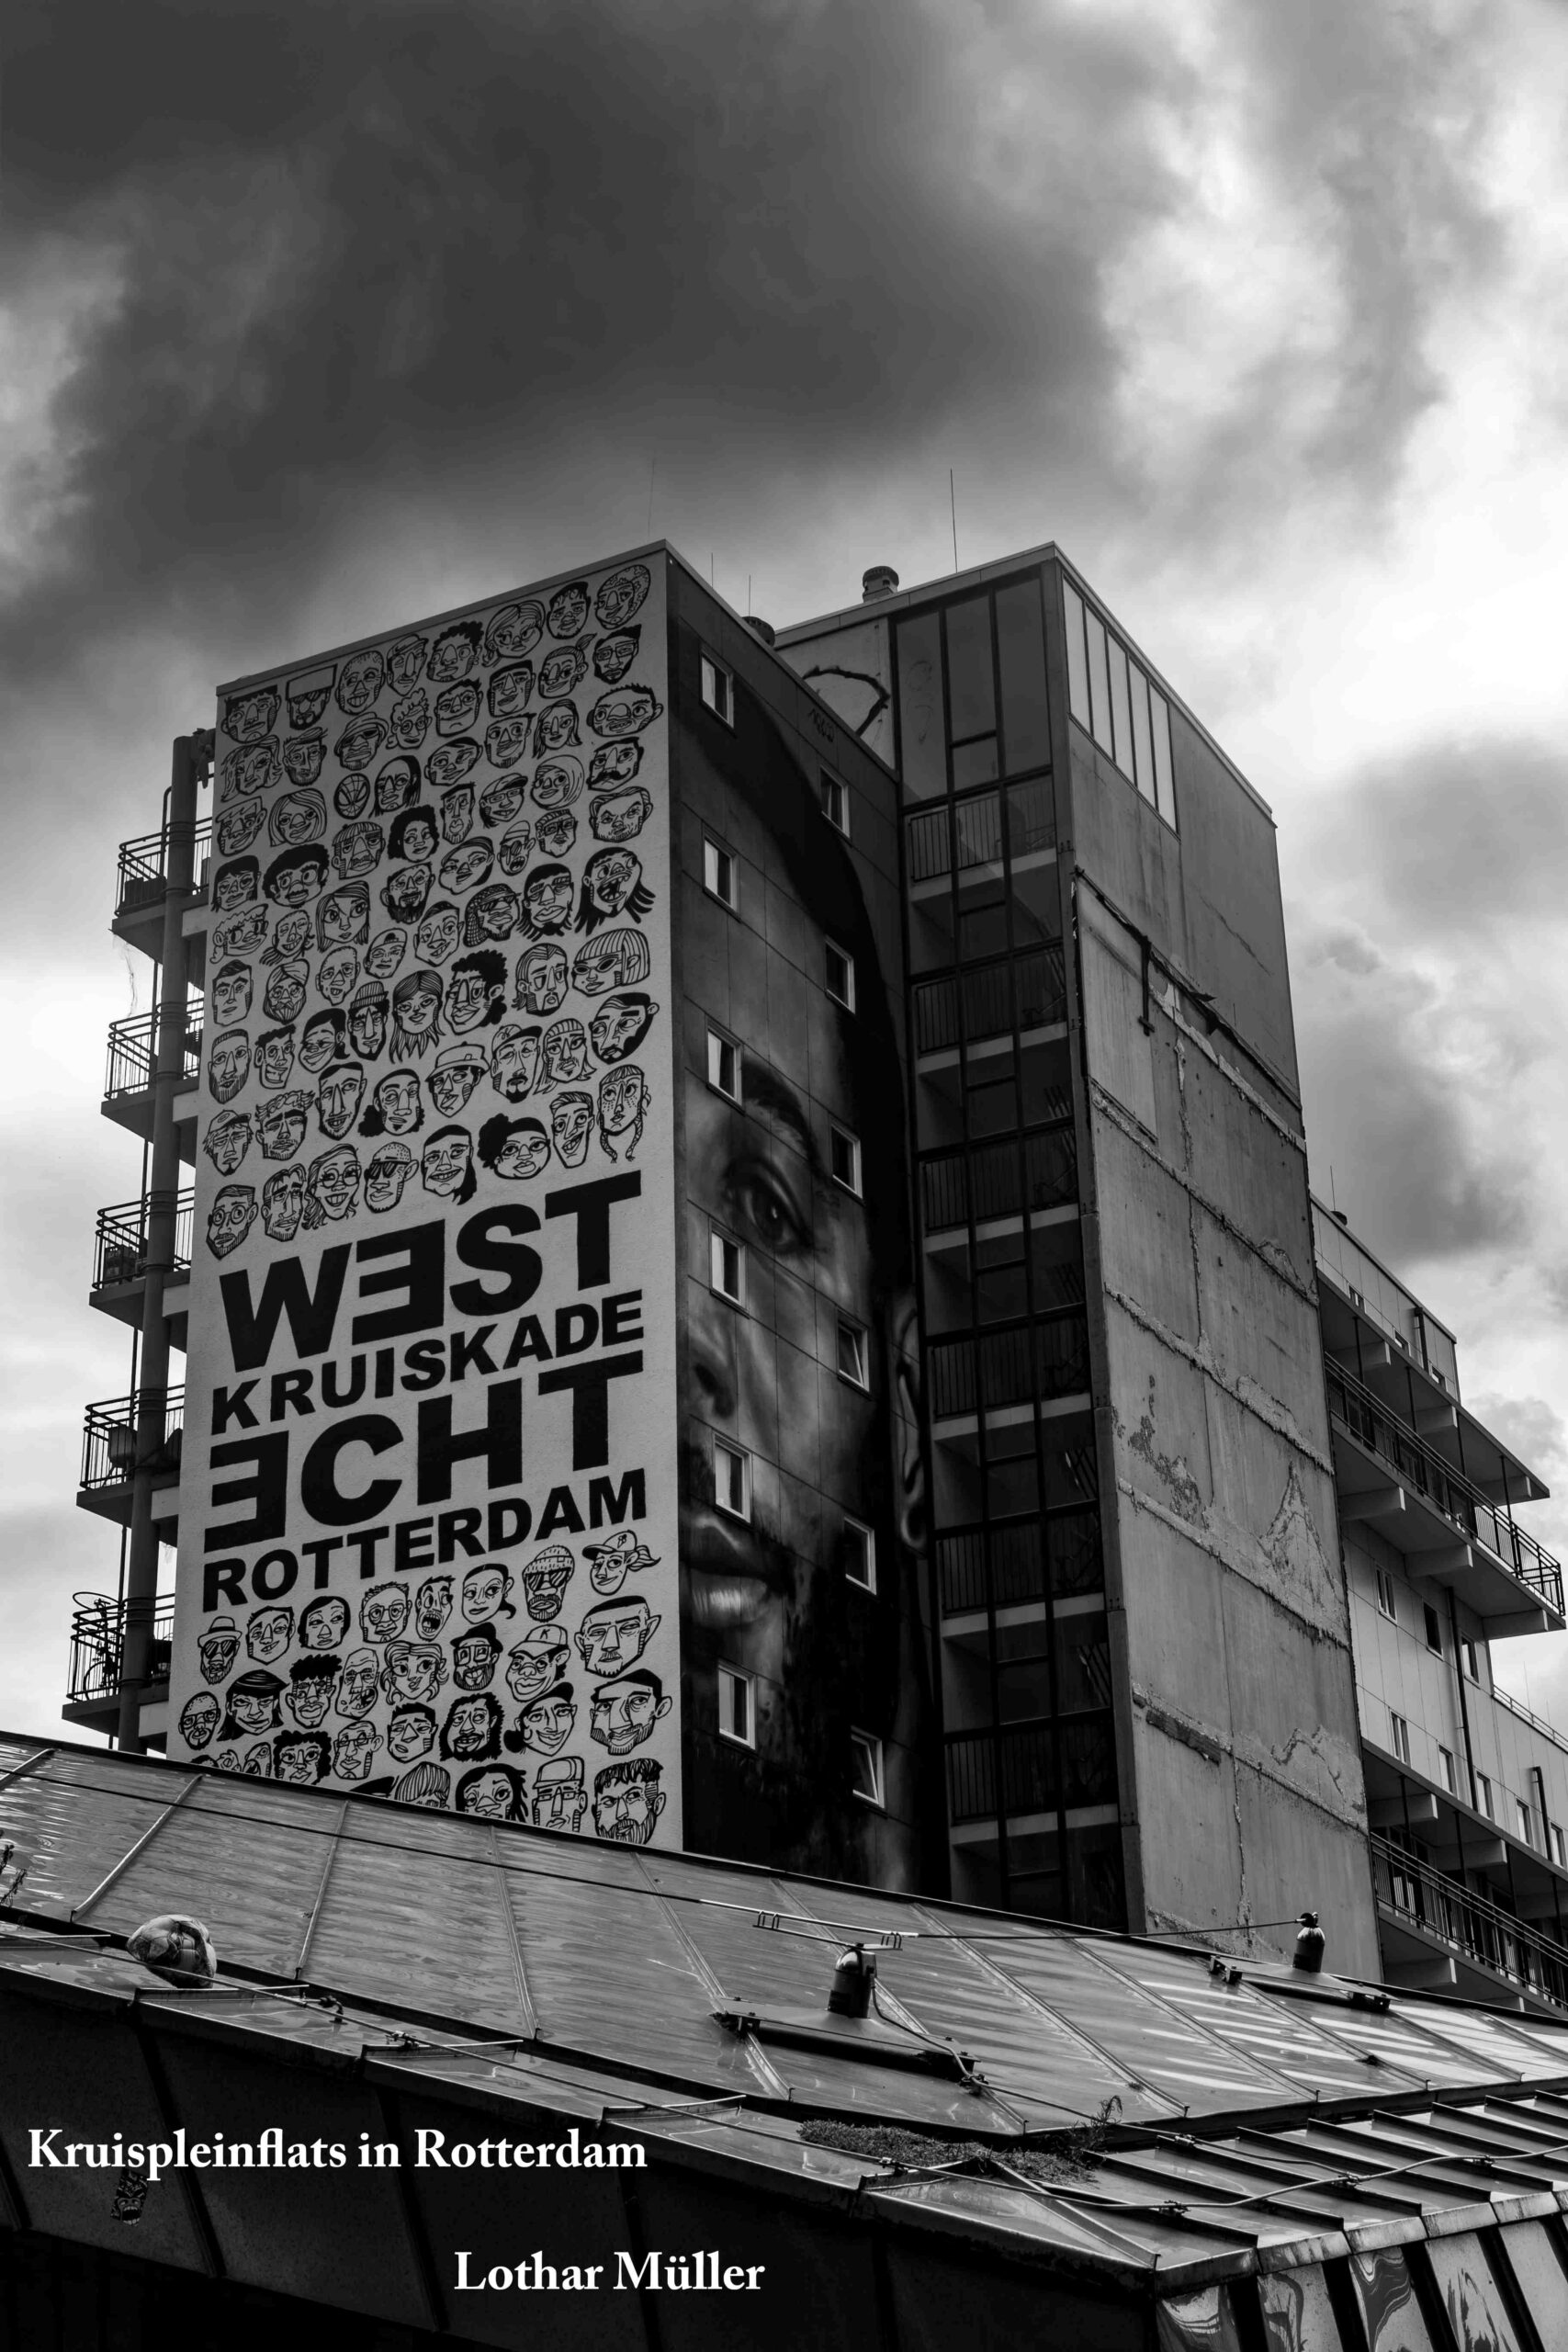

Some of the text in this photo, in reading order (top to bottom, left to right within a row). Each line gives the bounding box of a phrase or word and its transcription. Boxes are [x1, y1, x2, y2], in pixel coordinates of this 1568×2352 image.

[220, 1170, 641, 1373] WEST
[211, 1290, 643, 1435] KRUISKADE
[204, 1351, 644, 1554] ECHT
[203, 1468, 647, 1612] ROTTERDAM
